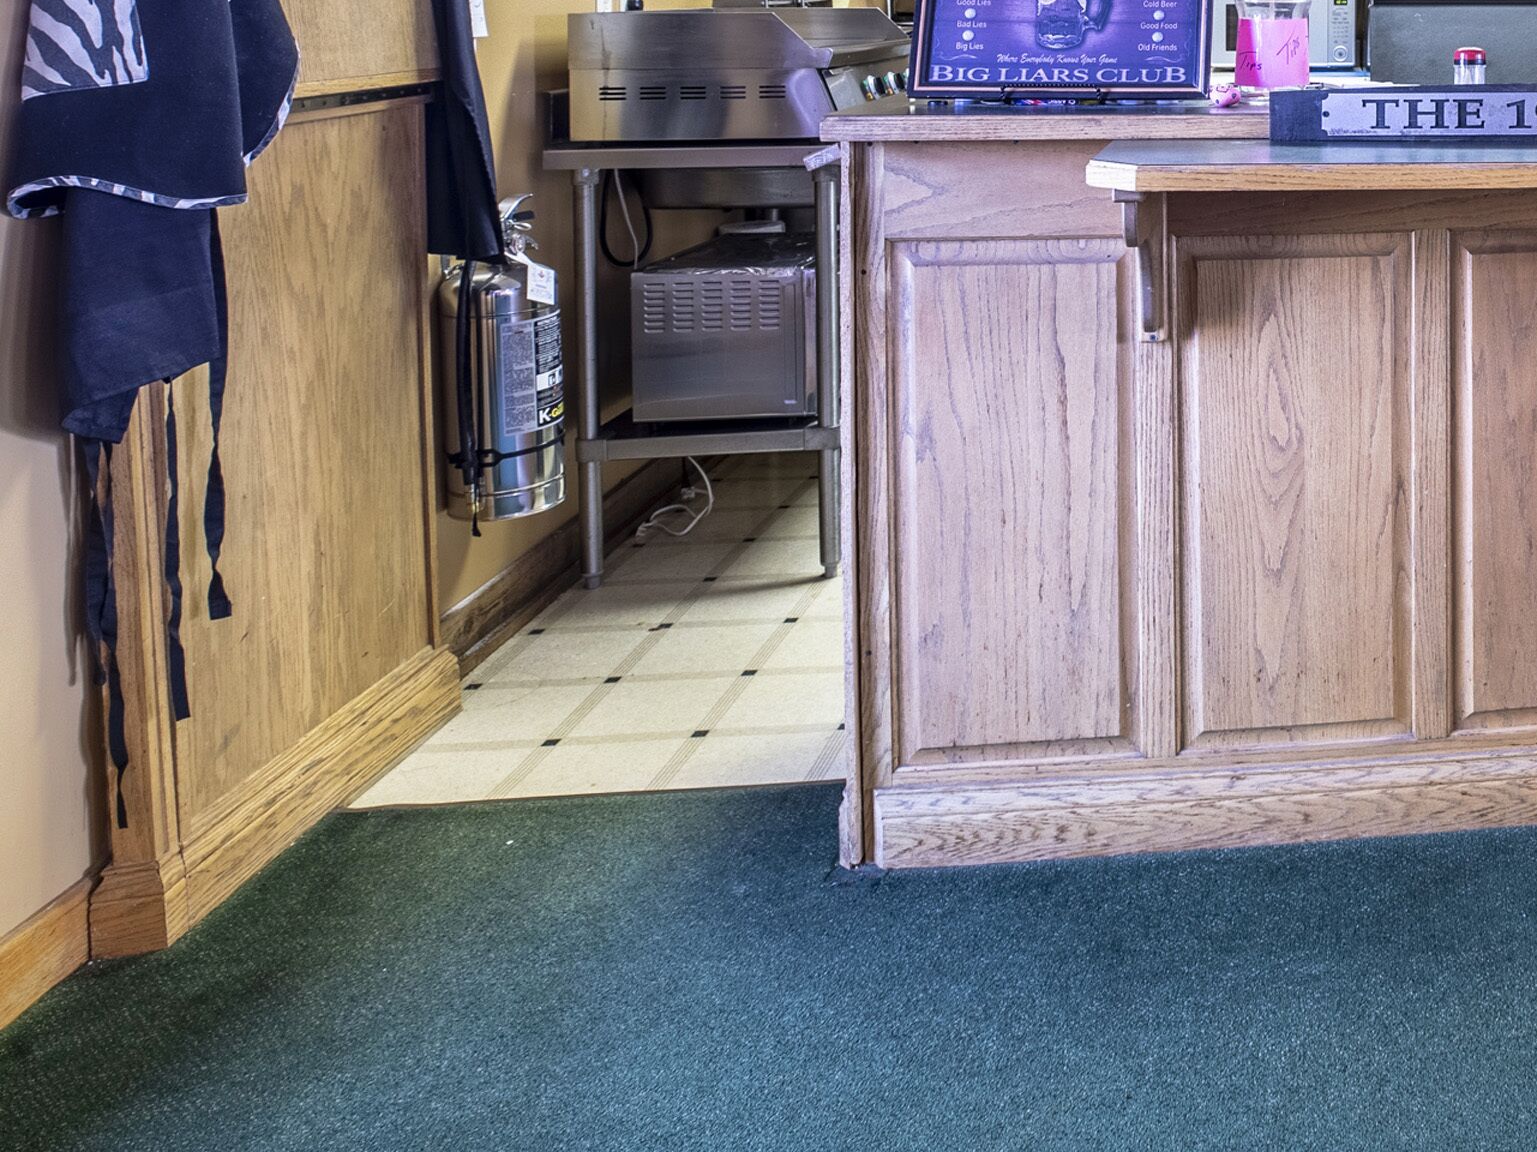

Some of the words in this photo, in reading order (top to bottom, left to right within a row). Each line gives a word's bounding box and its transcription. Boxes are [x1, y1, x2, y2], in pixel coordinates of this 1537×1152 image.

[1143, 0, 1161, 8] Cold
[1163, 0, 1177, 8] Beer
[957, 20, 970, 28] Bad
[1140, 22, 1159, 30] Good
[1161, 22, 1177, 30] Food
[956, 42, 967, 51] Big
[969, 43, 984, 51] Lies
[1138, 44, 1150, 52] Old
[1152, 44, 1177, 52] Friends
[997, 54, 1018, 64] Where
[1020, 53, 1054, 65] Everybody
[1057, 54, 1079, 64] Knows
[1081, 54, 1097, 64] Your
[1099, 55, 1117, 64] Game
[930, 65, 991, 83] BIG
[1000, 68, 1089, 83] LIARS
[1096, 66, 1187, 84] CLUB
[1361, 98, 1486, 130] THE
